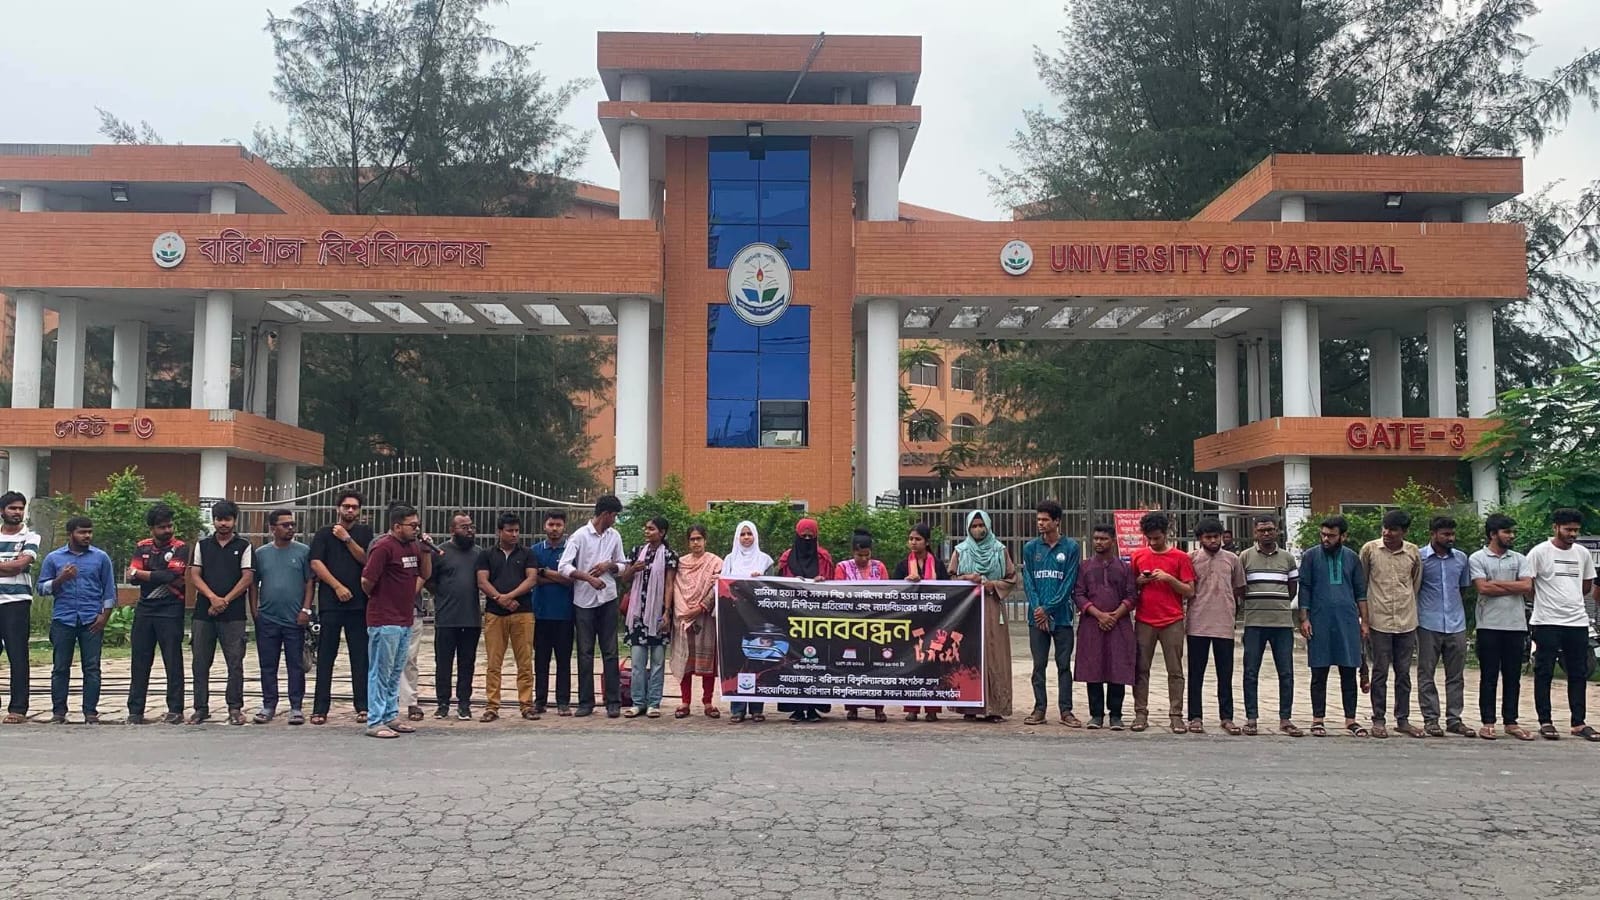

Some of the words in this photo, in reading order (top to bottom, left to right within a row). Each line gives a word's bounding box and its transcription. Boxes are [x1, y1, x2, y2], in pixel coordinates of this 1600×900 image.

[198, 228, 305, 265] বরিশাল
[317, 230, 491, 268] বিশ্ববিদ্যালয়
[1049, 244, 1214, 273] UNIVERSITY
[1220, 245, 1257, 273] OF
[1266, 245, 1406, 274] BARISHAL
[797, 589, 809, 598] সহ
[810, 590, 828, 598] সকল
[846, 591, 852, 599] ও
[885, 590, 898, 599] প্রতি
[920, 592, 946, 600] চলমান
[856, 603, 871, 611] এবং
[919, 602, 942, 612] দাবিতে
[788, 616, 912, 645] মানববন্ধন
[818, 673, 845, 684] বরিশাল
[803, 685, 830, 695] বরিশাল
[884, 689, 902, 697] সকল
[904, 688, 934, 697] সামাজিক
[936, 688, 960, 698] সংগঠন
